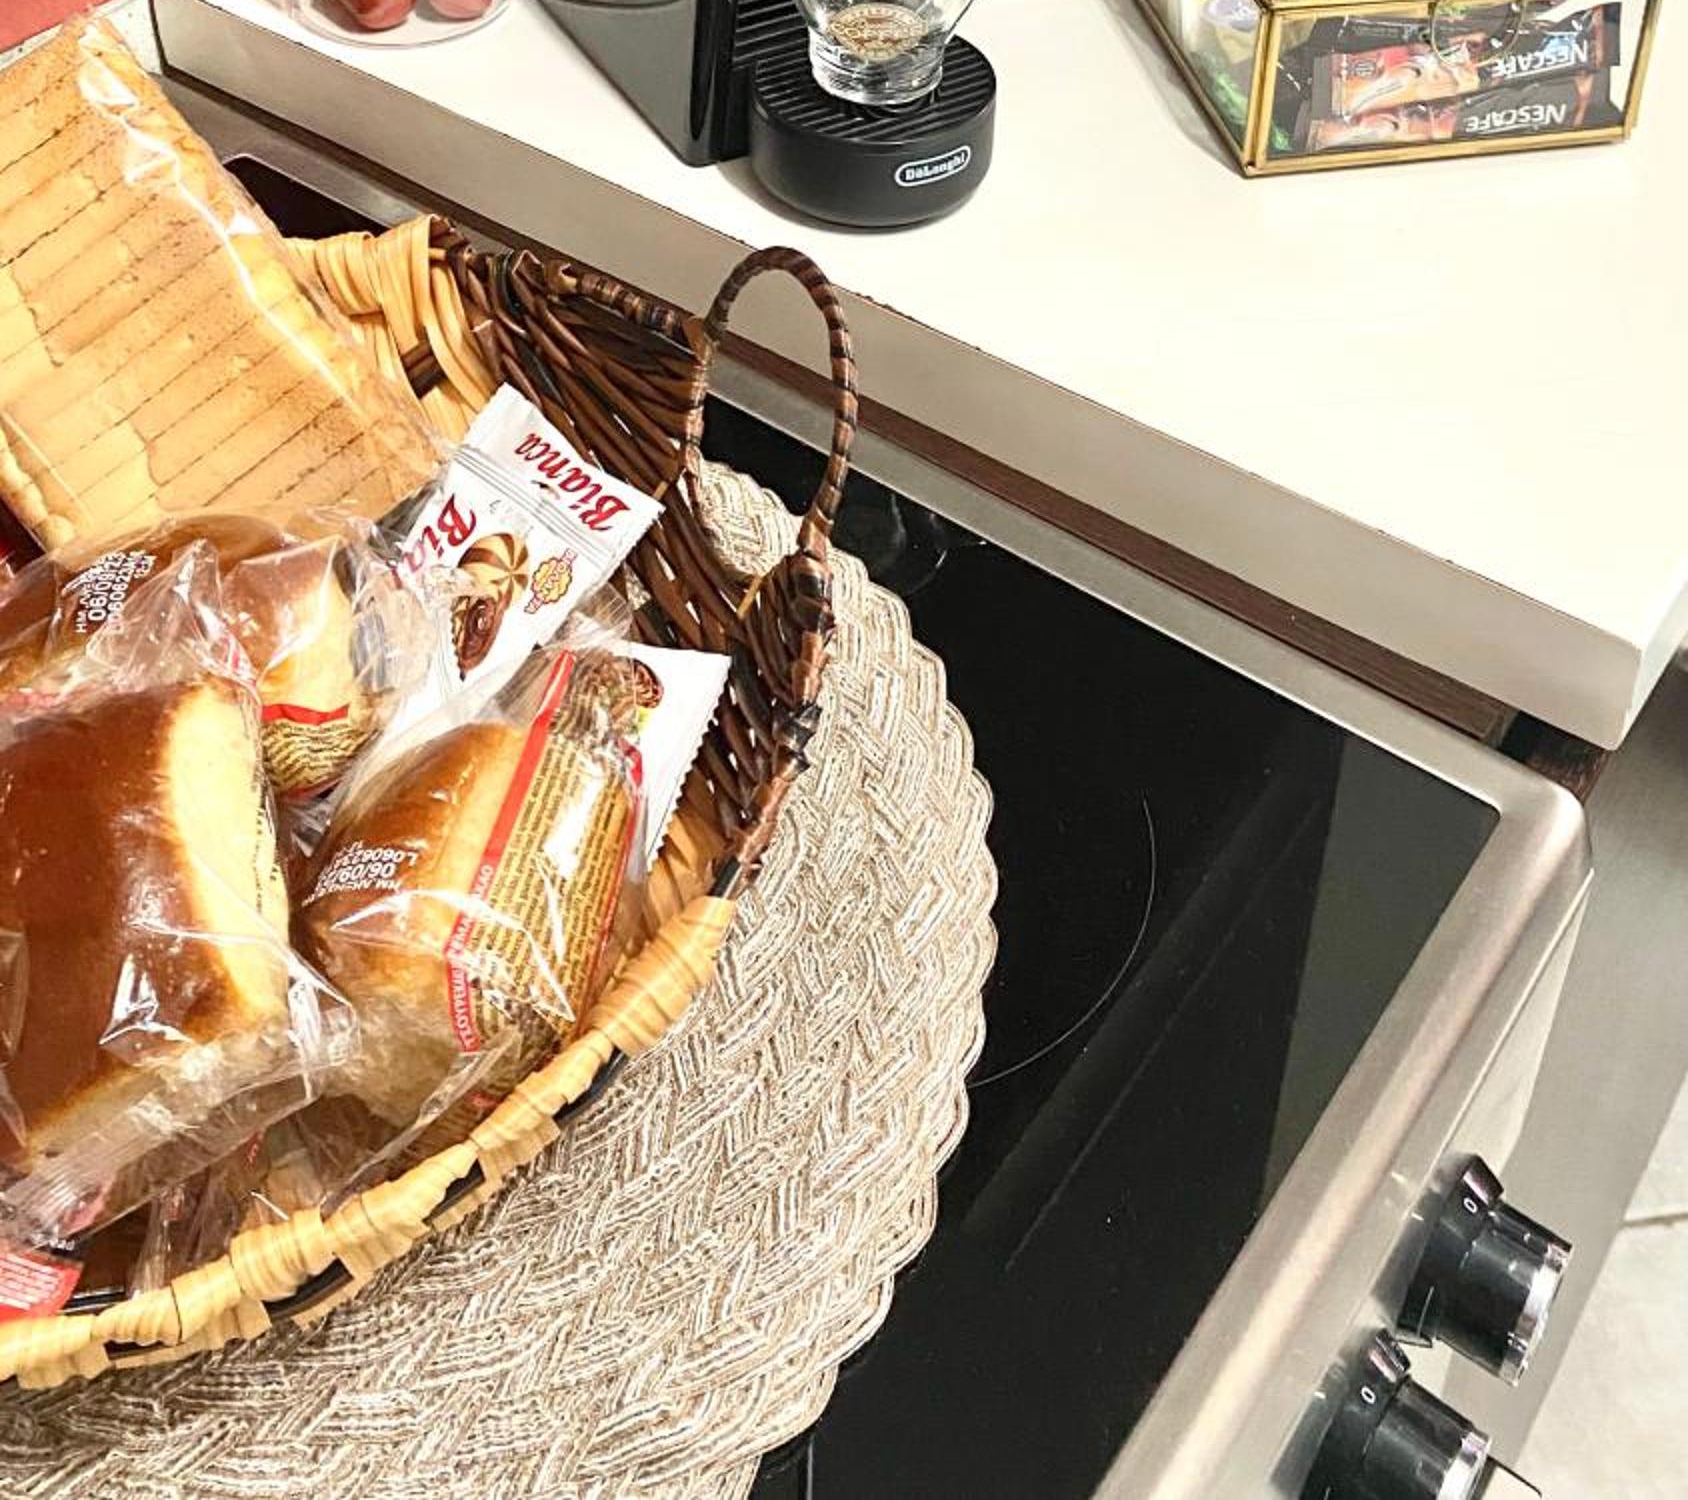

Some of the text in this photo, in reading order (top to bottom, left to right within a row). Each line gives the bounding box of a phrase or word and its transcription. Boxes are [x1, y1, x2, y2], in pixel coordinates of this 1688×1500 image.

[513, 432, 632, 532] Bianca
[386, 492, 478, 590] Bia
[1463, 1197, 1478, 1214] 0
[1360, 1386, 1377, 1404] 0
